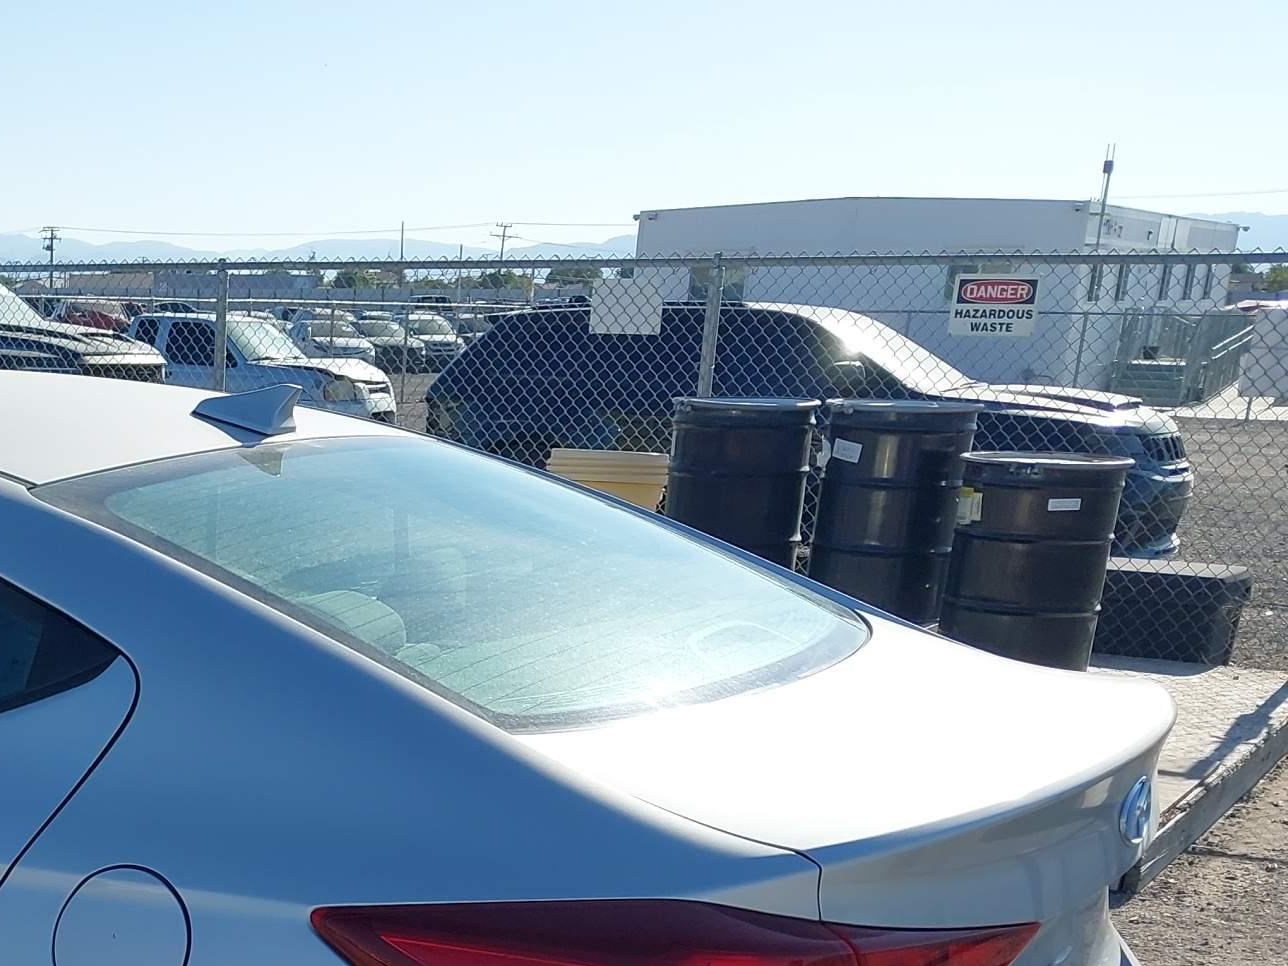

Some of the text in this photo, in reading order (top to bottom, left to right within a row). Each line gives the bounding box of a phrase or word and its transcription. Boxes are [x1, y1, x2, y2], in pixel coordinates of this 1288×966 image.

[966, 285, 1028, 299] DANGER
[954, 308, 1034, 320] HAZARDOUS
[970, 321, 1014, 333] WASTE
